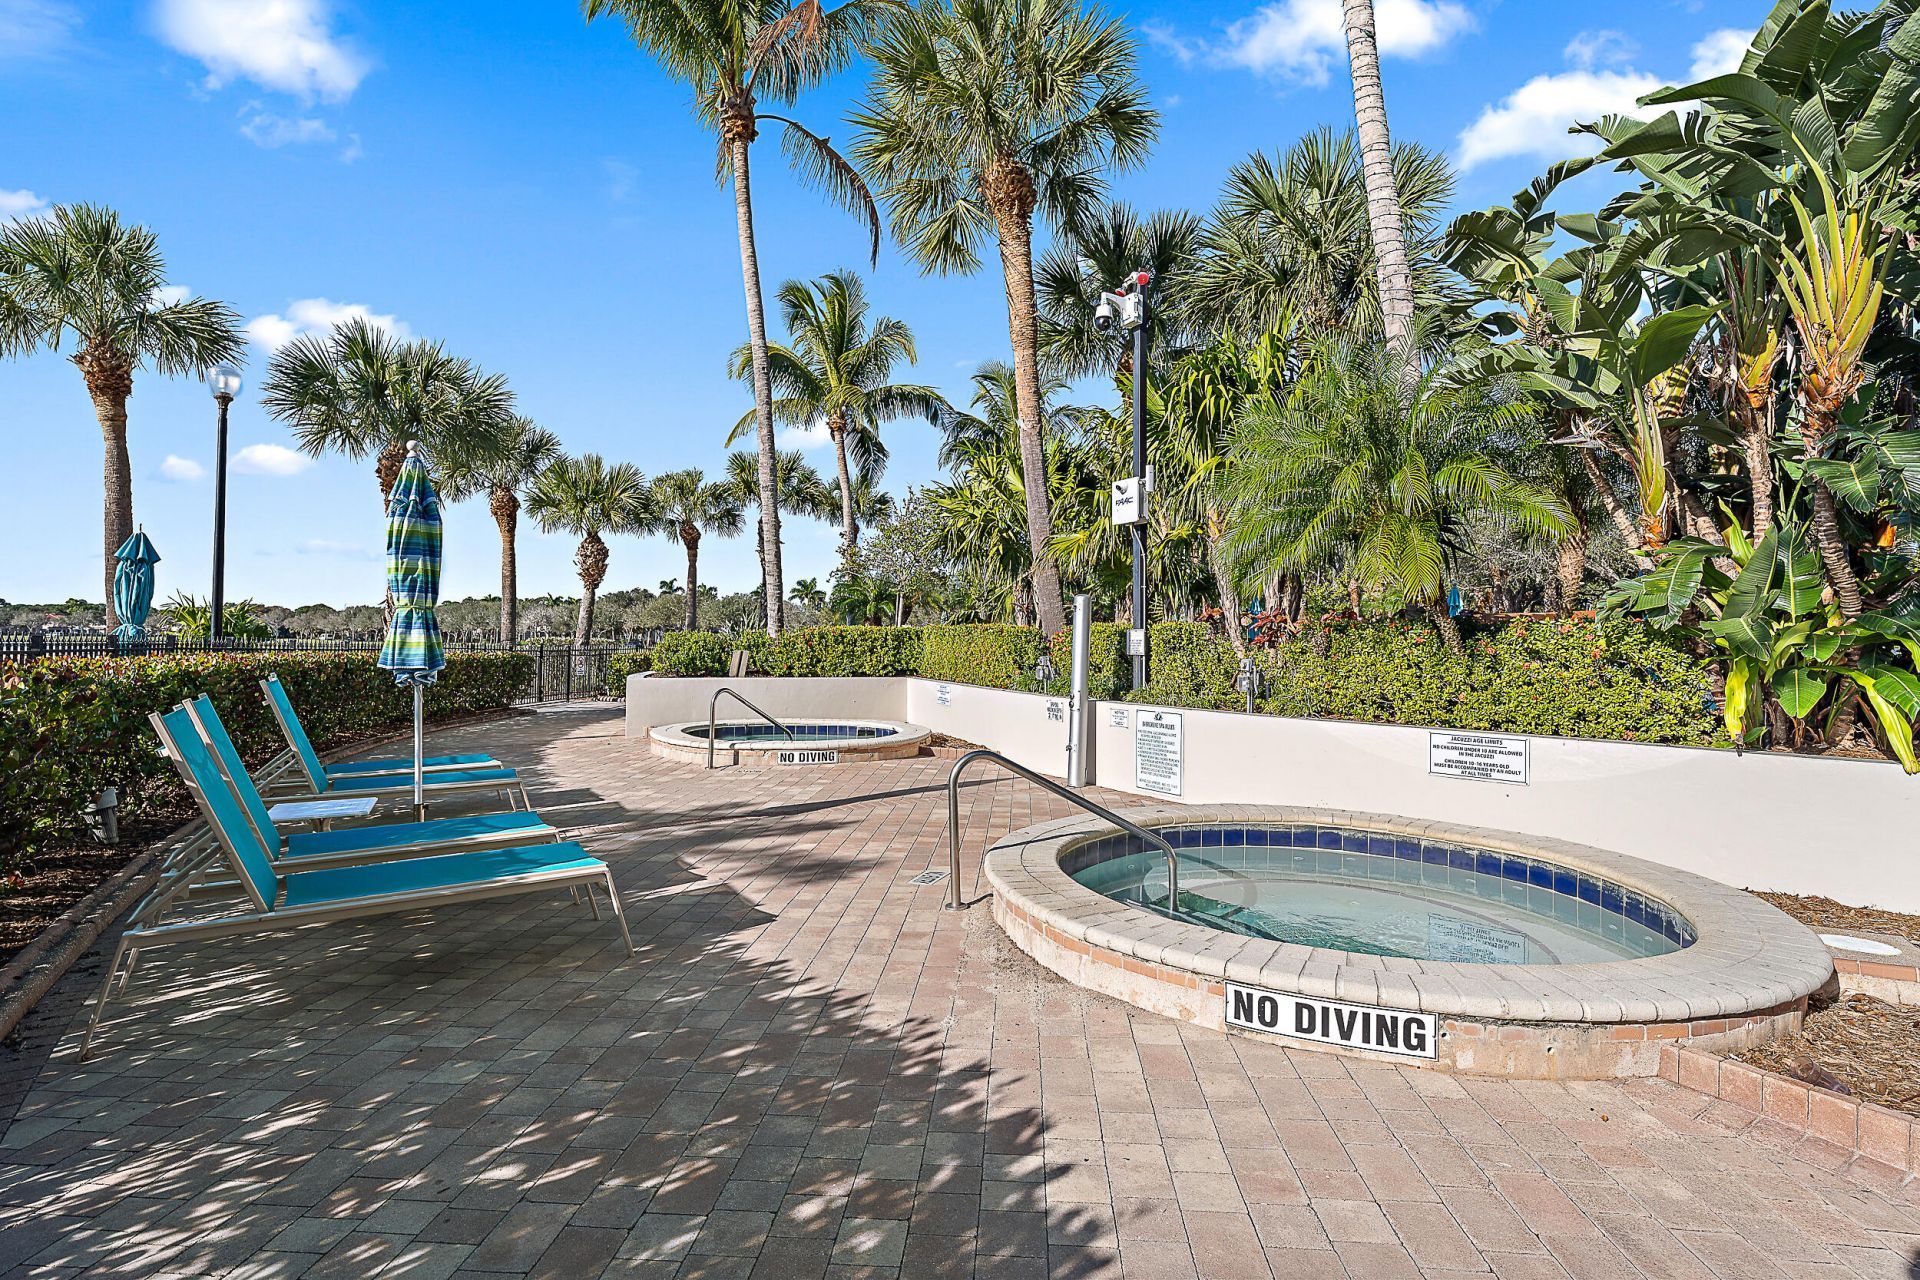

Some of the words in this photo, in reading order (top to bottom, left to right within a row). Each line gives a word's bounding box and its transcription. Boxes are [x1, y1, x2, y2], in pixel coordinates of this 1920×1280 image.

[780, 752, 794, 762] NO
[798, 751, 835, 762] DIVING
[1234, 989, 1279, 1028] NO
[1295, 1001, 1426, 1052] DIVING
